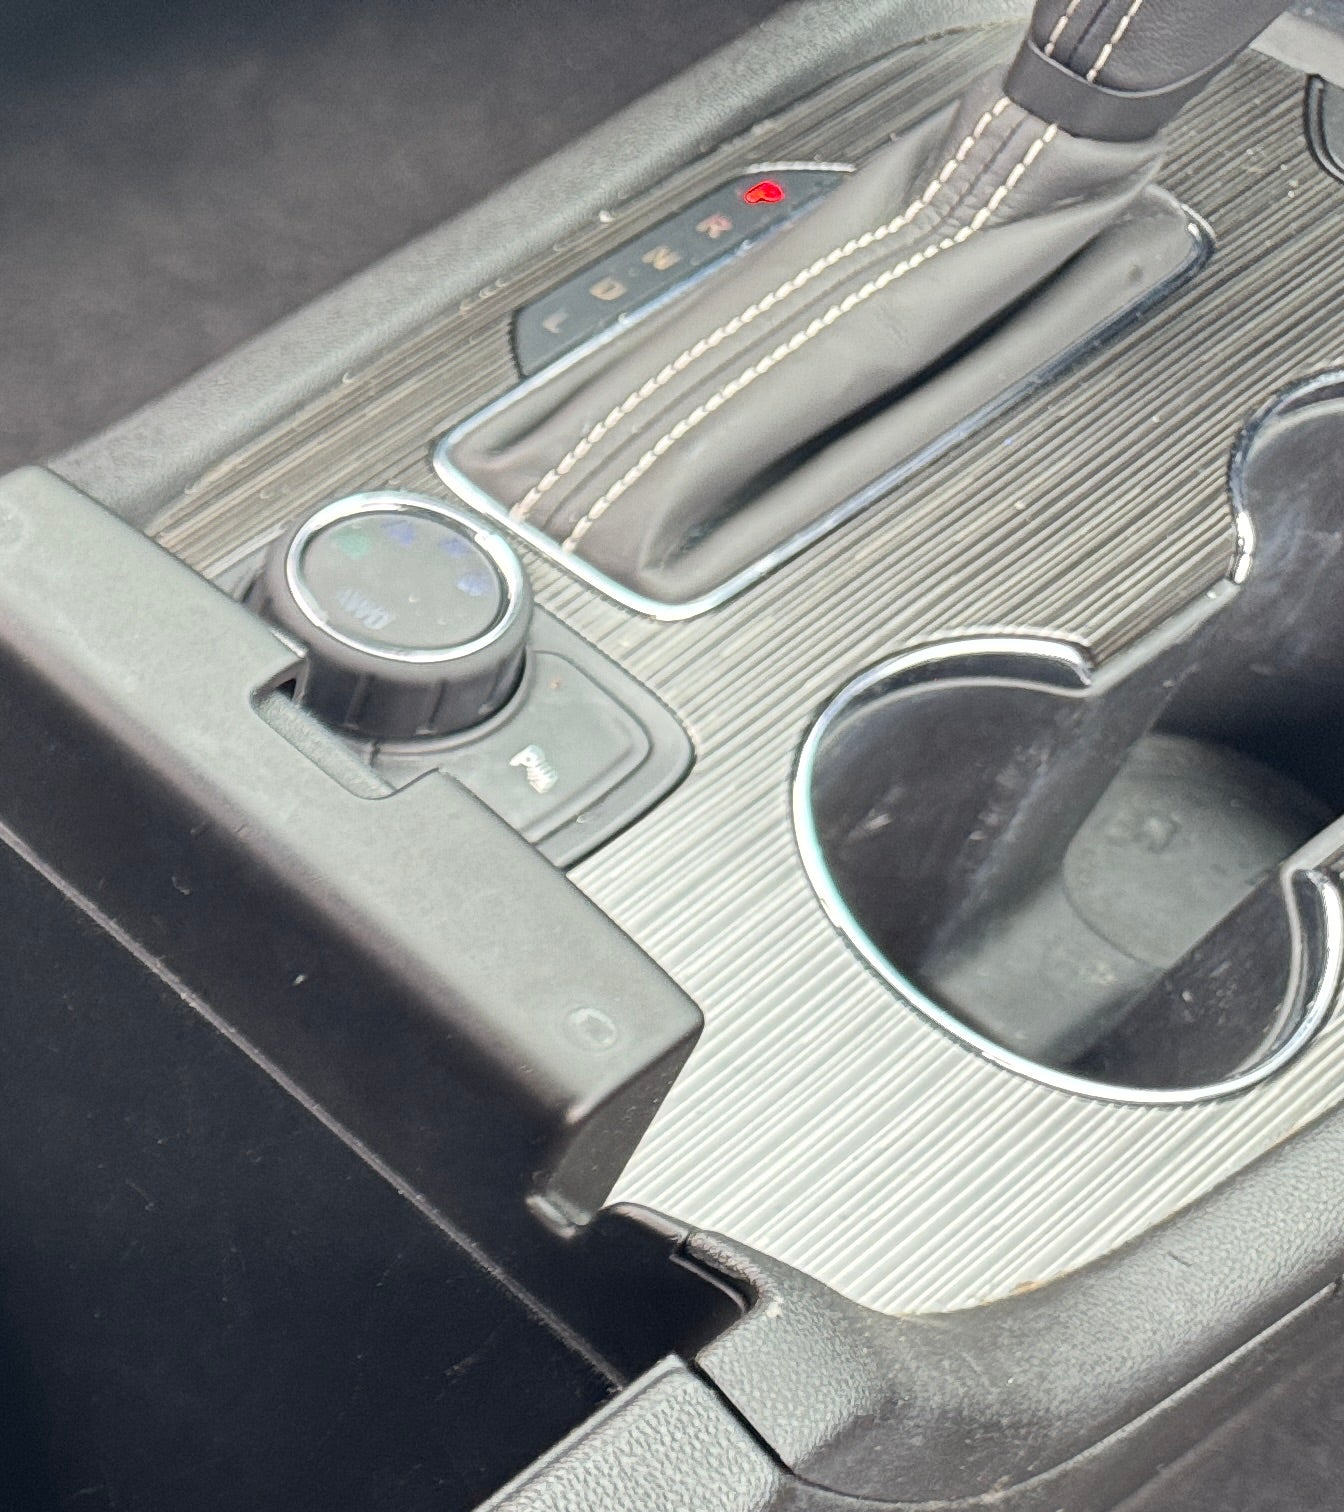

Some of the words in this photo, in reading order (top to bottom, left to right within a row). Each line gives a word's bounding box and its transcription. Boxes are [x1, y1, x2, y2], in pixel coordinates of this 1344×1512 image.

[696, 213, 733, 239] R
[642, 246, 681, 271] N
[590, 277, 627, 301] D
